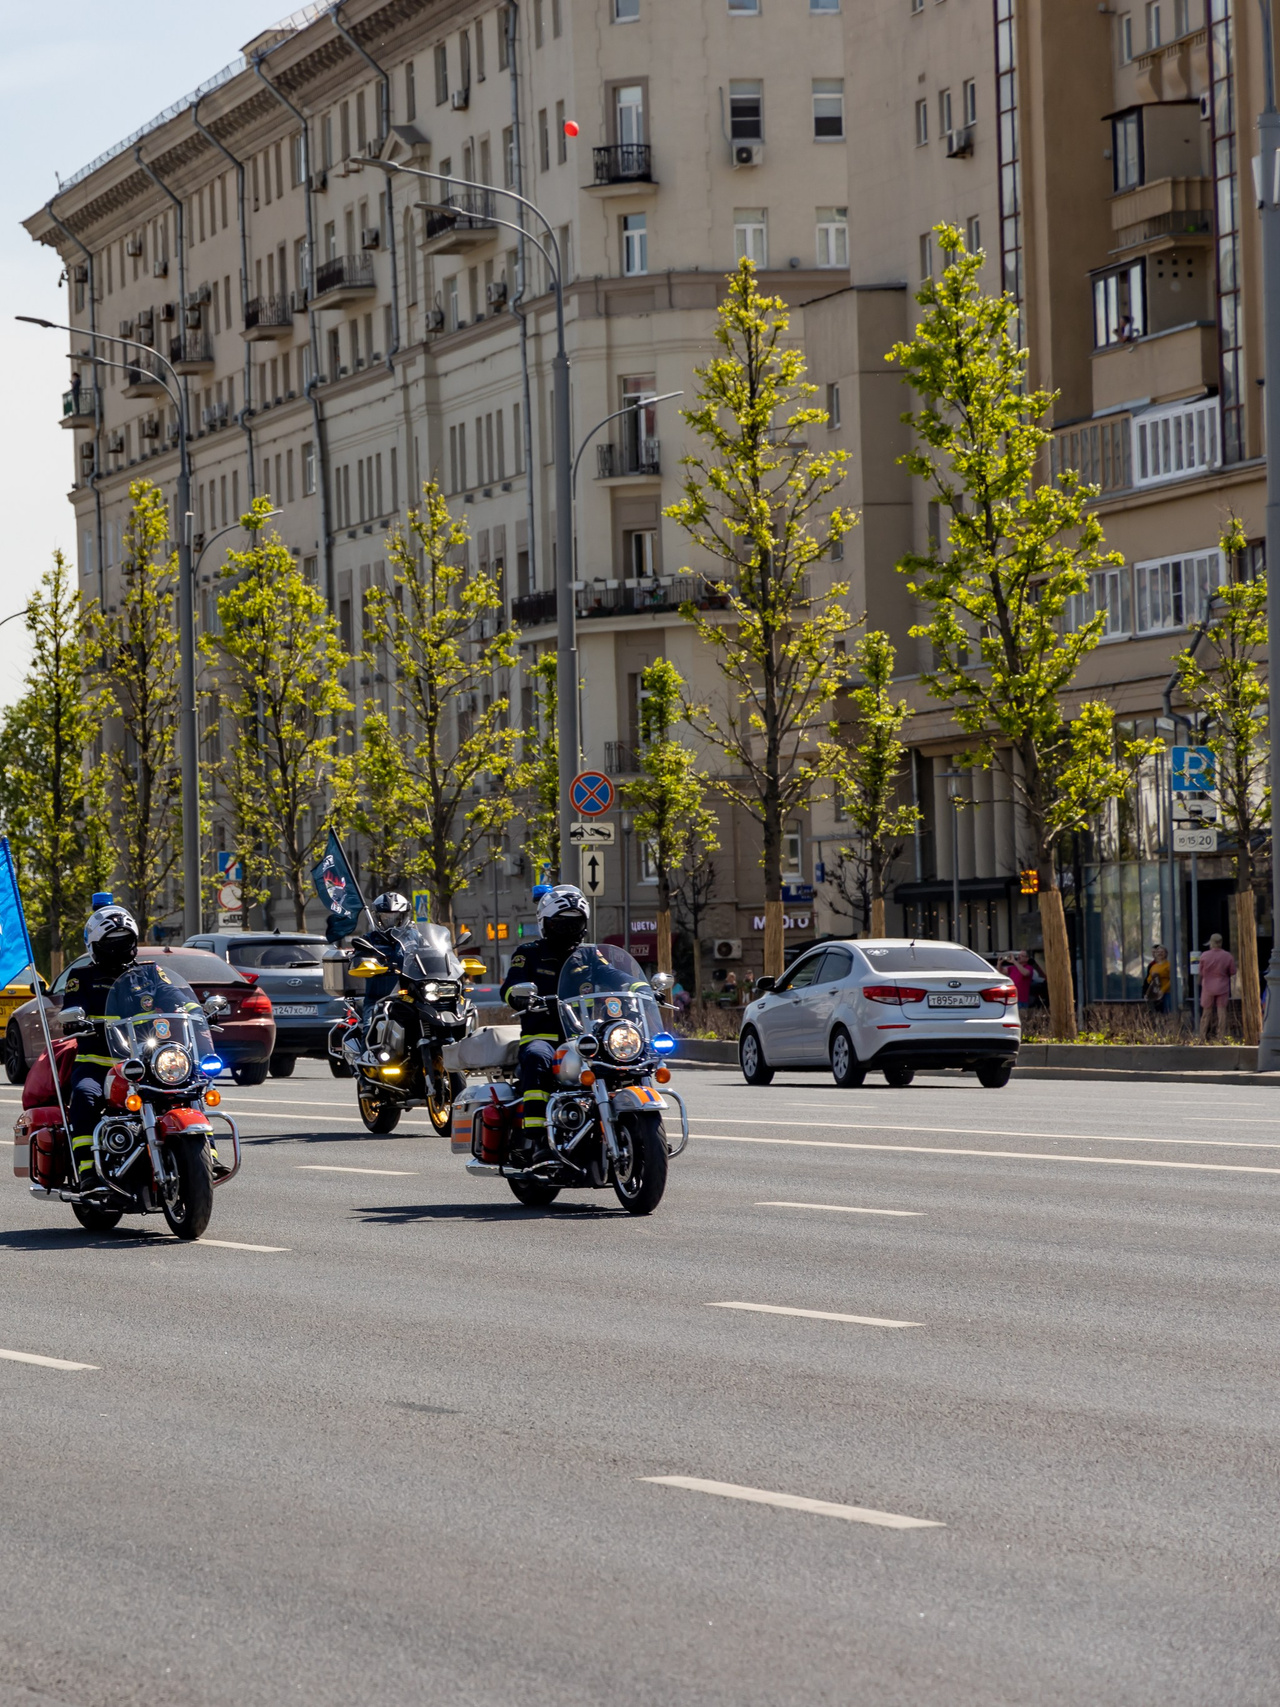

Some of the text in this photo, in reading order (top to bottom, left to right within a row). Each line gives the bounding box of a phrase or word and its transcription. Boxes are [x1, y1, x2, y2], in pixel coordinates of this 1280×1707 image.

[1184, 751, 1207, 787] P
[1188, 836, 1196, 845] 15
[1199, 835, 1212, 846] 20
[631, 921, 657, 932] ЦВЕТЫ
